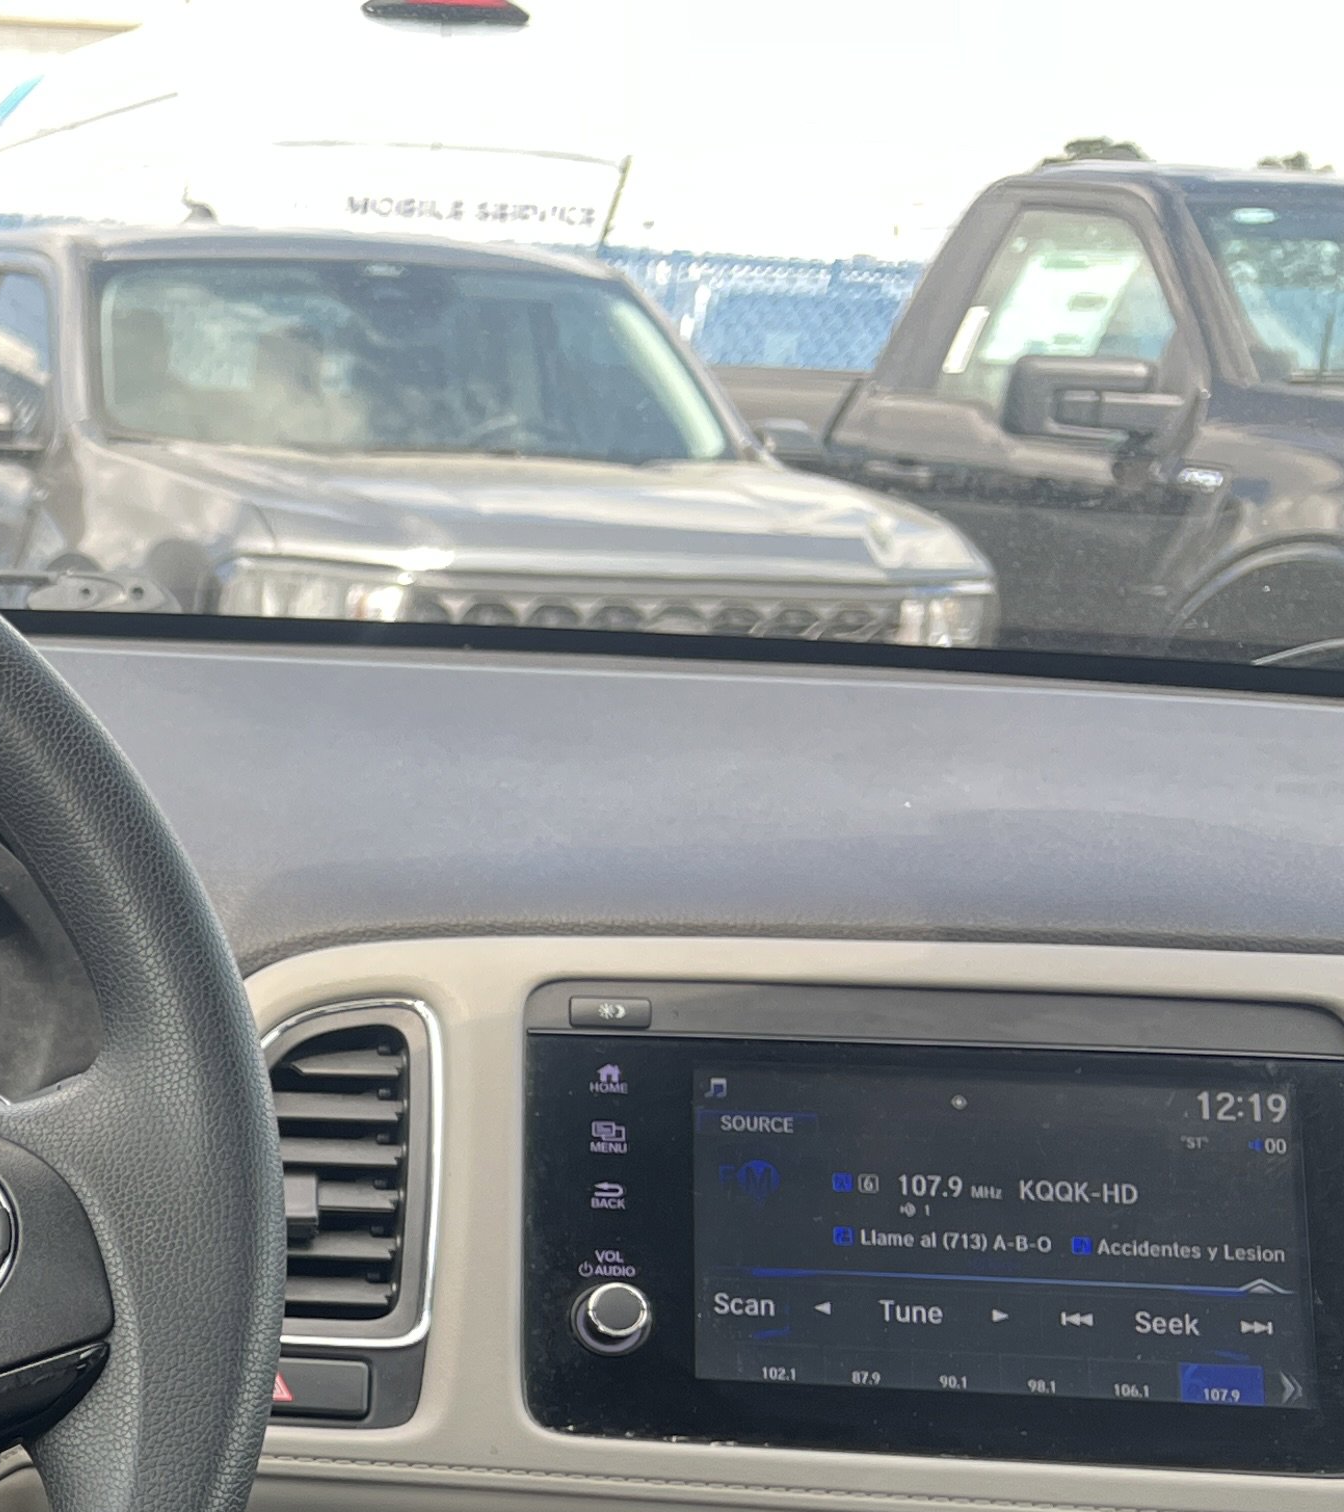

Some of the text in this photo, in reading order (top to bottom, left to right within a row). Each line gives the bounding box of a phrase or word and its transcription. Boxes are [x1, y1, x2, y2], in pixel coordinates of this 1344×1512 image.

[346, 196, 463, 220] MOBILE
[590, 1082, 628, 1094] HOME
[1196, 1090, 1288, 1124] 12:19
[720, 1115, 795, 1134] SOURCE
[590, 1141, 628, 1154] MENU
[898, 1173, 963, 1198] 107.9
[970, 1185, 1003, 1201] MHz
[1018, 1178, 1139, 1205] KQQK-HD
[591, 1198, 626, 1210] BACK
[860, 1228, 1052, 1254] Llame al (713) A-B-O
[594, 1250, 625, 1263] VOL
[1097, 1238, 1286, 1263] Accidentes y Lesion
[594, 1264, 636, 1278] AUDIO
[714, 1292, 776, 1317] Scan
[878, 1299, 944, 1325] Tune
[1134, 1310, 1200, 1337] Seek
[761, 1366, 796, 1382] 102.1
[851, 1371, 881, 1386] 87.9
[939, 1375, 968, 1390] 90.1
[1027, 1379, 1056, 1394] 98.1
[1113, 1382, 1150, 1398] 106.1
[1203, 1387, 1241, 1402] 107.9
